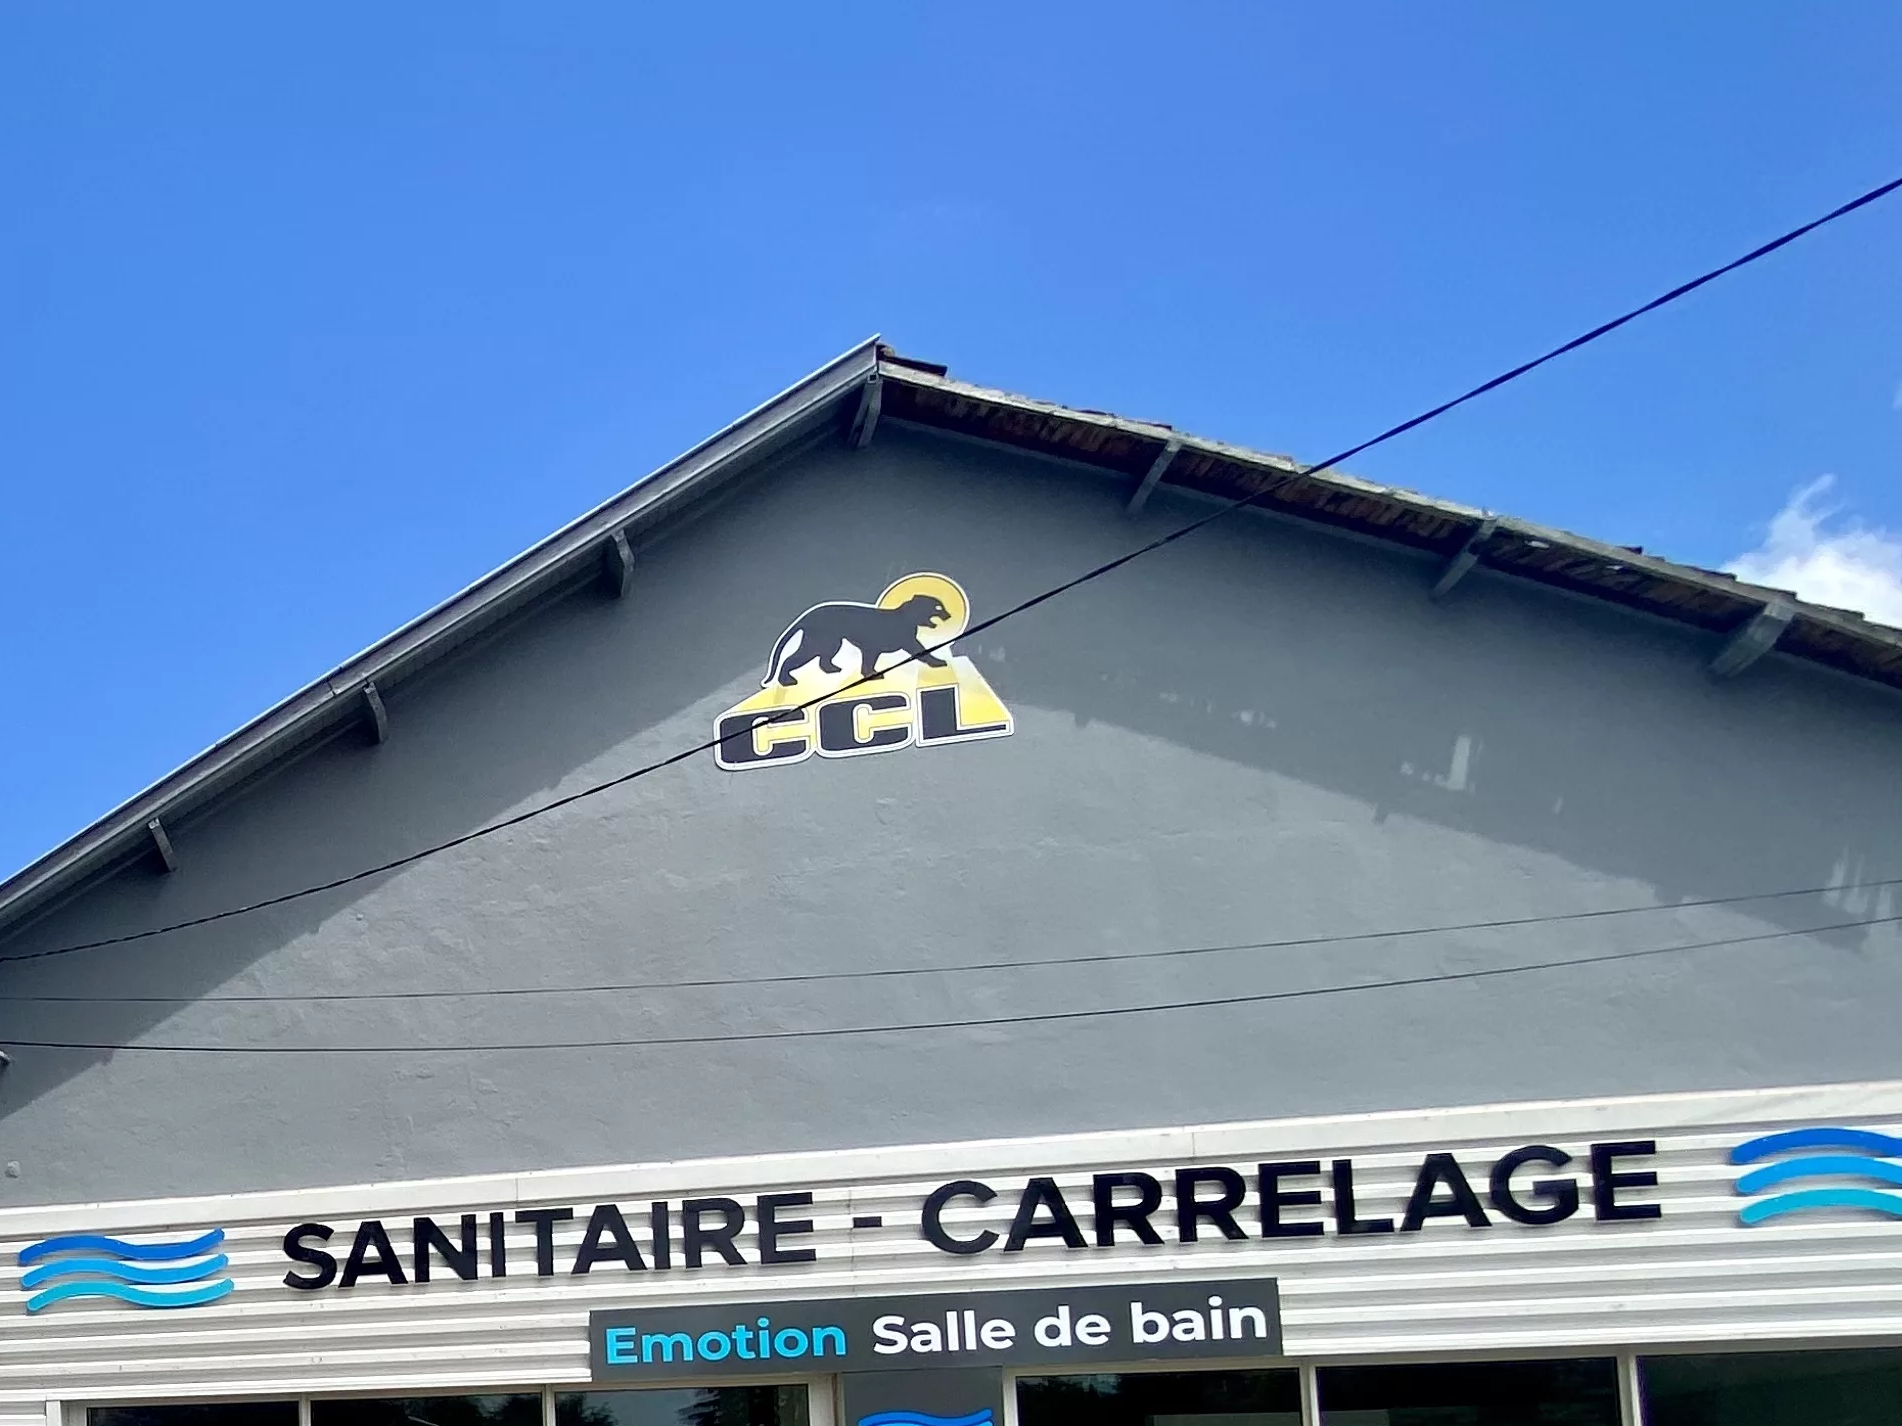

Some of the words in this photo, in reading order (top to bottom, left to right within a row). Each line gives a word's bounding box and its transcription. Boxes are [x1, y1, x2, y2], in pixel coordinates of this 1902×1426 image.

[715, 685, 1012, 768] CCL
[282, 1191, 817, 1289] SANITAIRE
[920, 1140, 1663, 1255] CARRELAGE
[605, 1317, 847, 1364] Emotion
[871, 1309, 1015, 1356] Salle
[1033, 1304, 1111, 1348] de
[1132, 1296, 1267, 1344] bain
